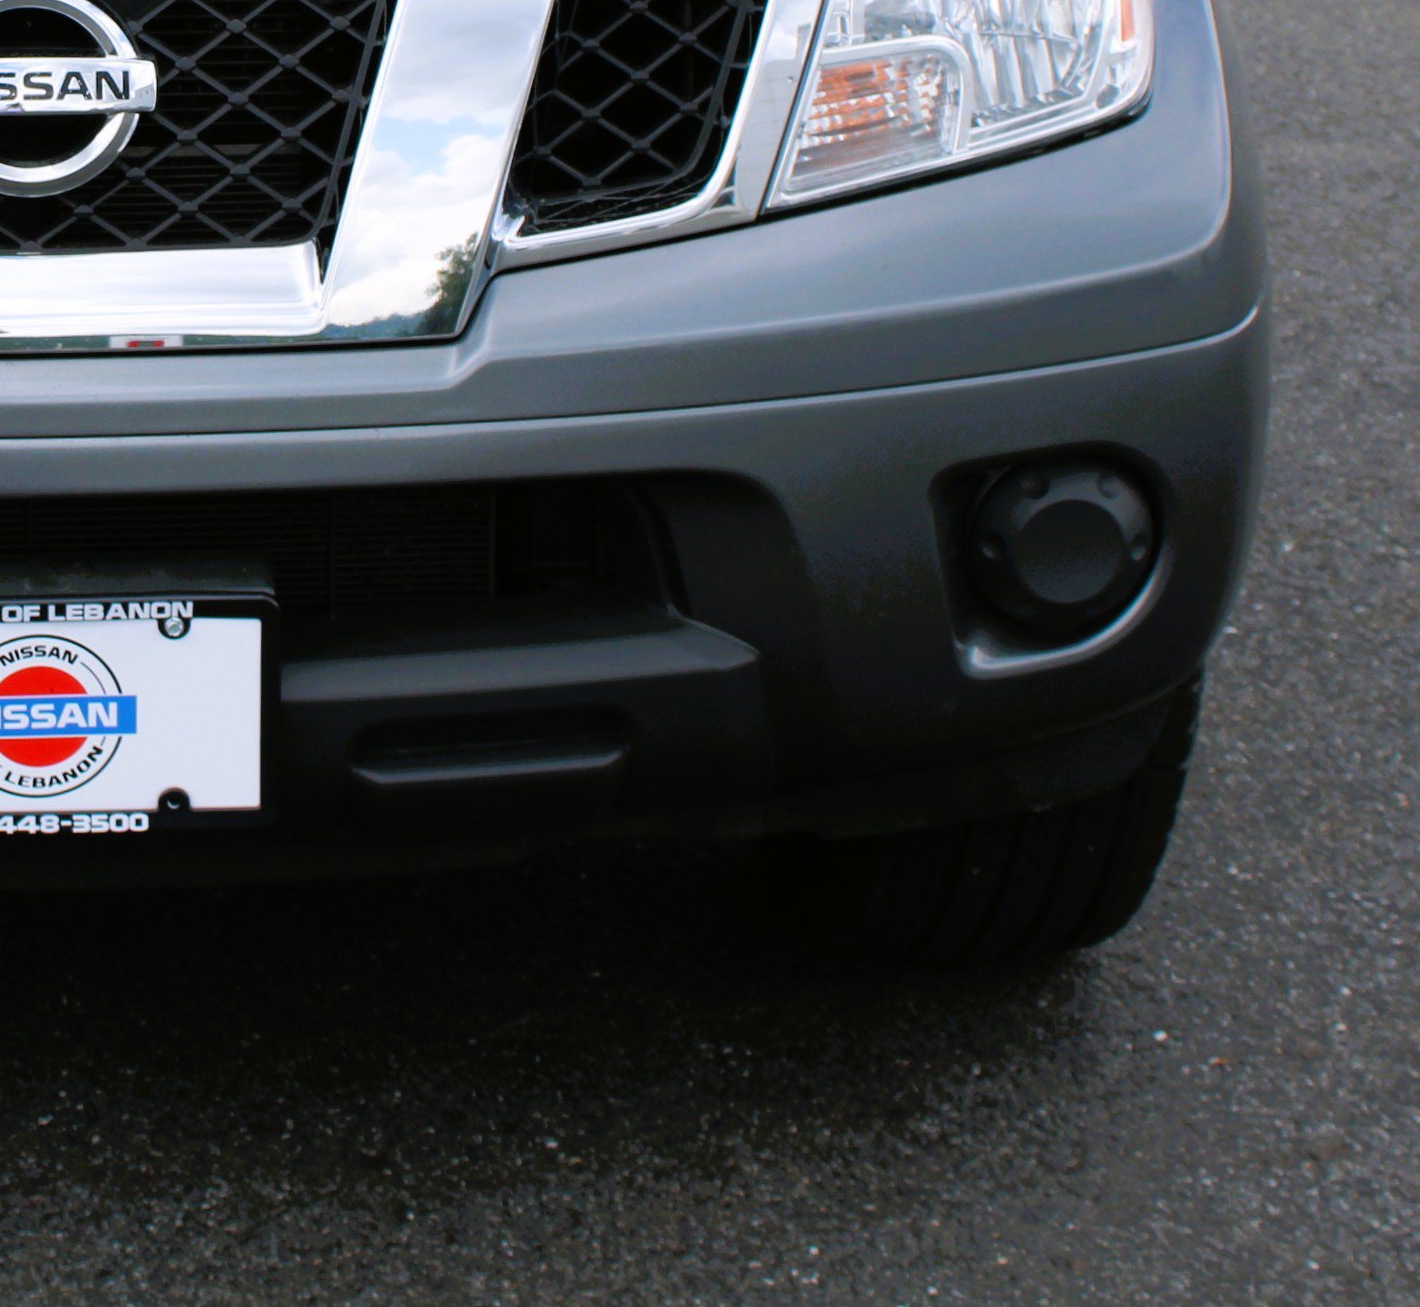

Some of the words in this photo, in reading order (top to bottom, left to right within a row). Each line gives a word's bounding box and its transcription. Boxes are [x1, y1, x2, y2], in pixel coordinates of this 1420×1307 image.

[1, 605, 40, 623] OF
[48, 601, 194, 622] LEBANON
[4, 745, 103, 788] LEBANON
